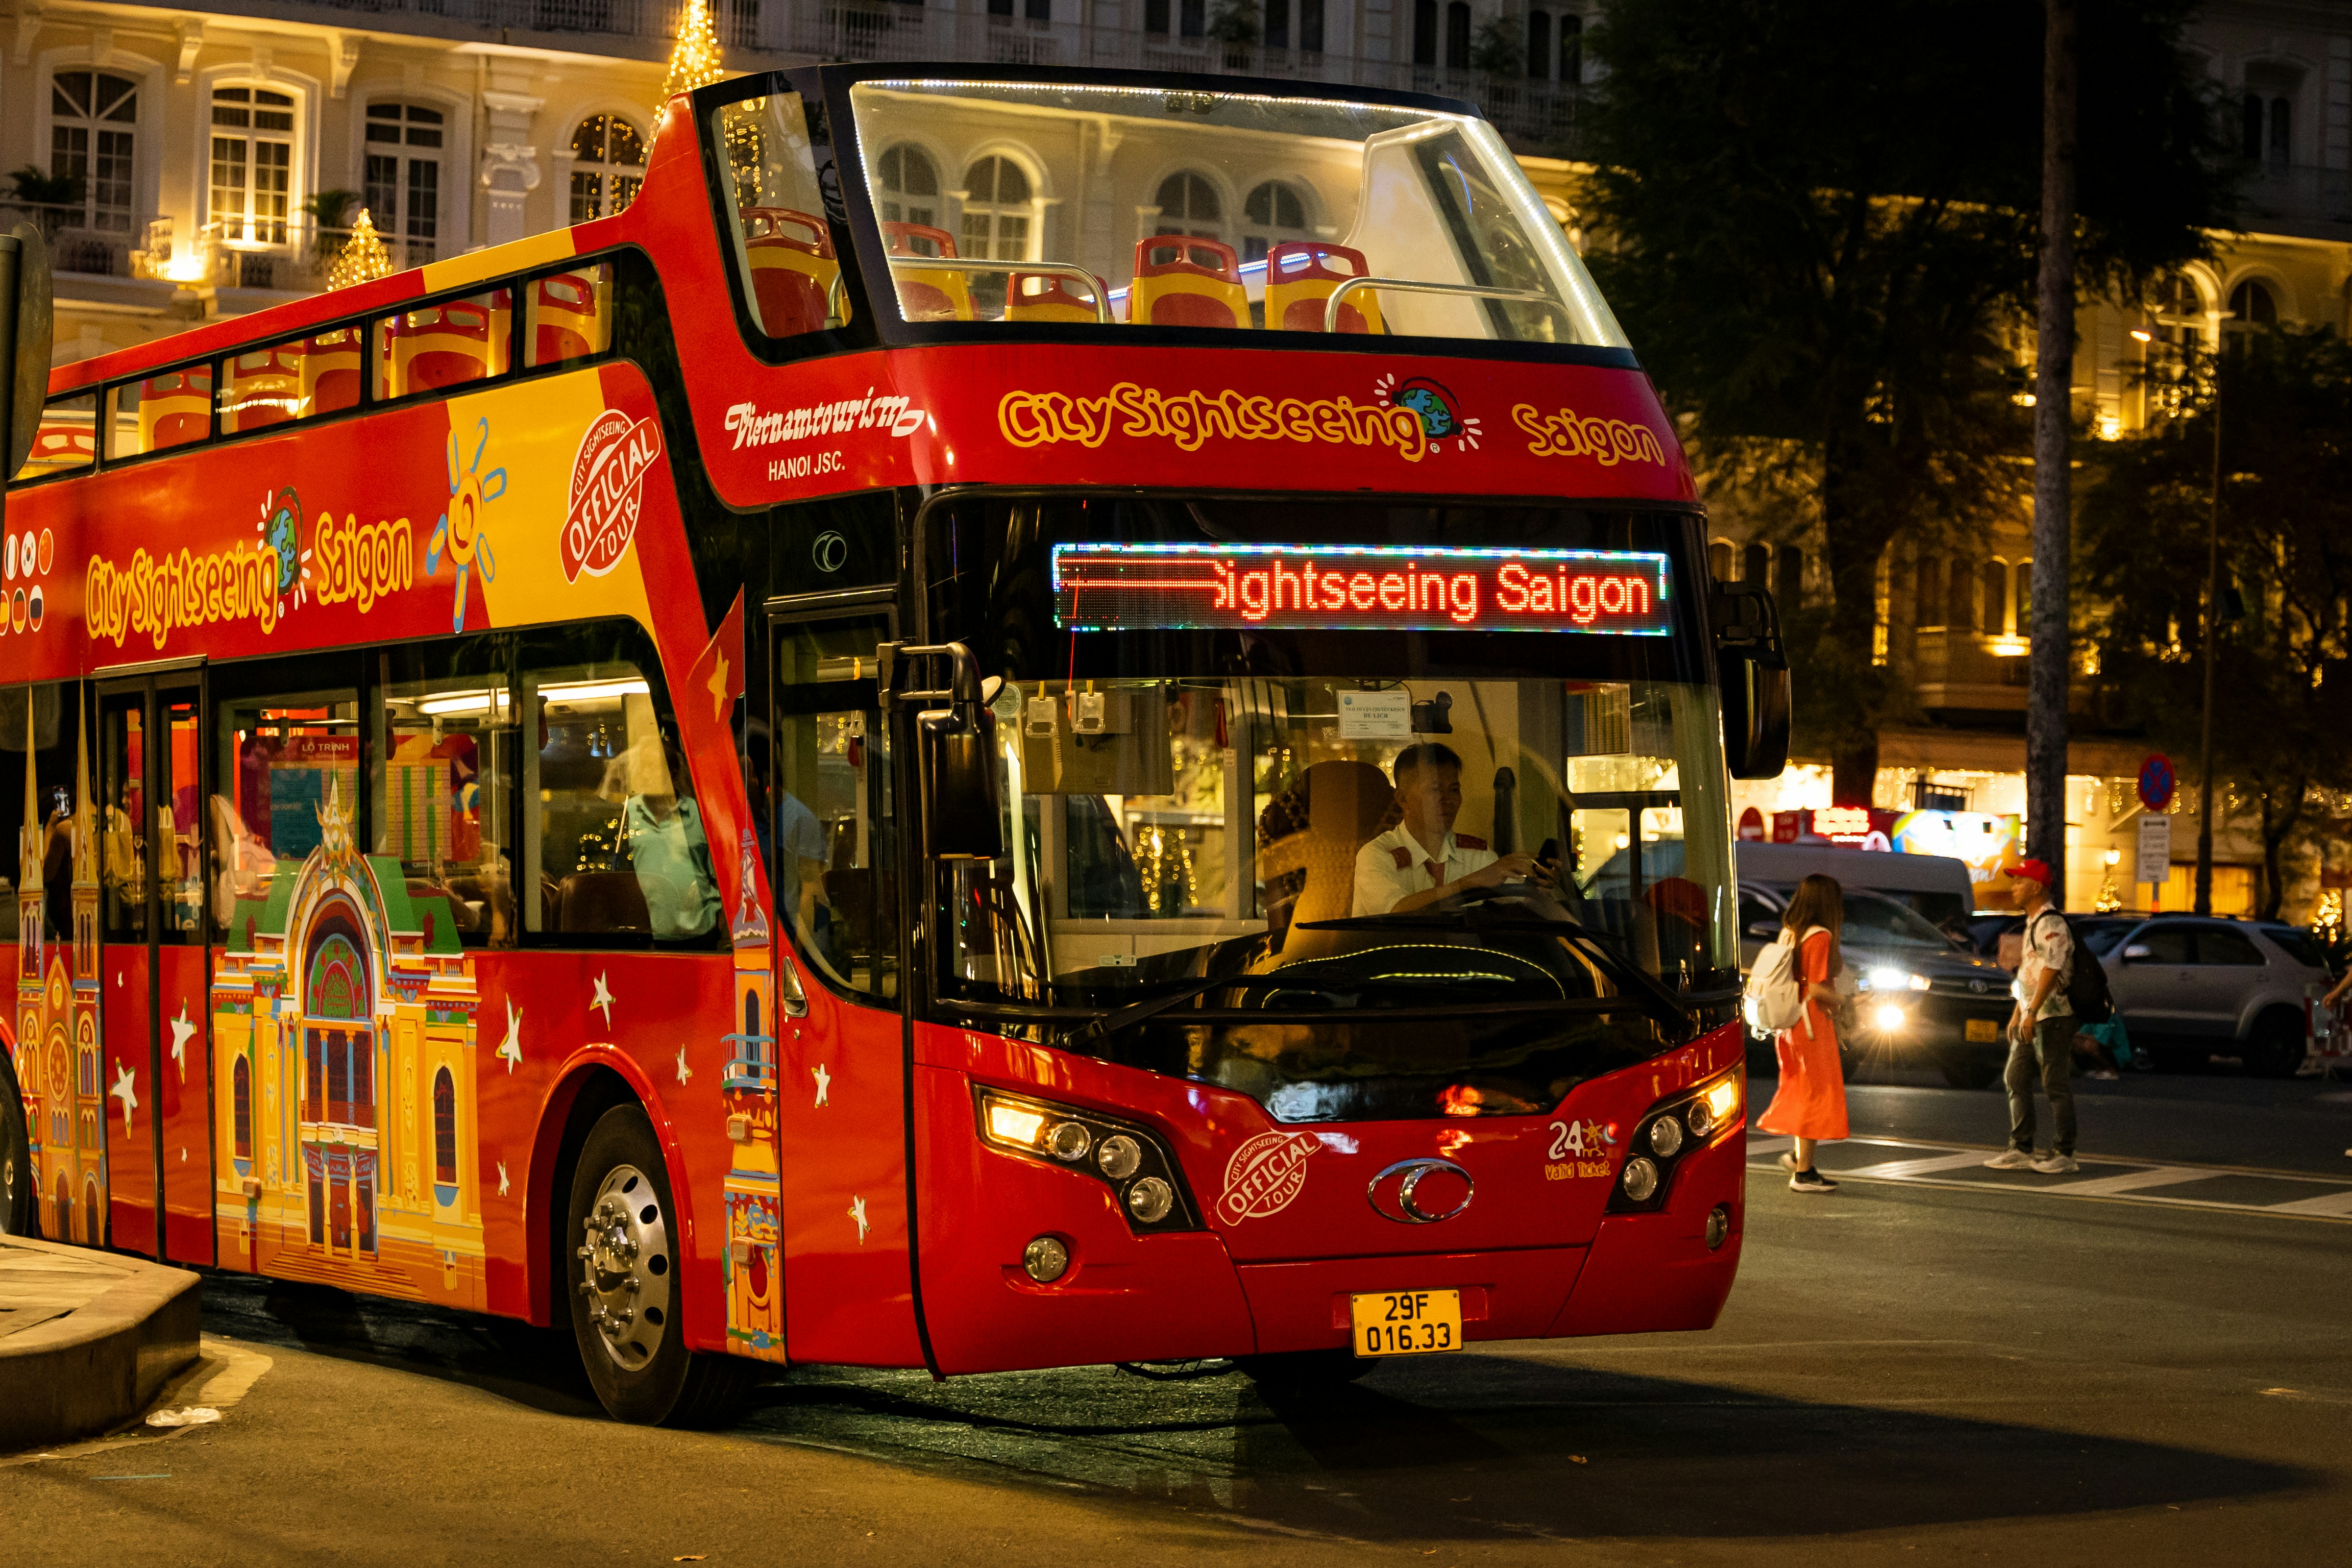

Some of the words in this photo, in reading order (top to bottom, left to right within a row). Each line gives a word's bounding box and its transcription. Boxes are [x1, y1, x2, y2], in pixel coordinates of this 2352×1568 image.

[724, 386, 925, 451] Vietnamtourism
[1512, 403, 1665, 467] Saigon
[574, 459, 586, 496] CITY
[584, 420, 626, 463] SIGHTSEEING
[768, 455, 811, 481] HANOI
[814, 450, 845, 475] JSC.
[569, 428, 654, 561] OFFICIAL
[599, 496, 638, 562] TOUR
[315, 511, 412, 614] Saigon
[1497, 562, 1650, 624] Saigon
[1231, 1163, 1242, 1181] CITY
[1239, 1136, 1284, 1163] SIGHTSEEING
[1545, 1162, 1574, 1181] Valid
[1577, 1160, 1611, 1178] Ticket
[1548, 1120, 1584, 1160] 24
[1228, 1136, 1317, 1213] OFFICIAL
[1263, 1171, 1303, 1209] TOUR
[1366, 1322, 1451, 1352] 016.33
[1383, 1294, 1429, 1321] 29F
